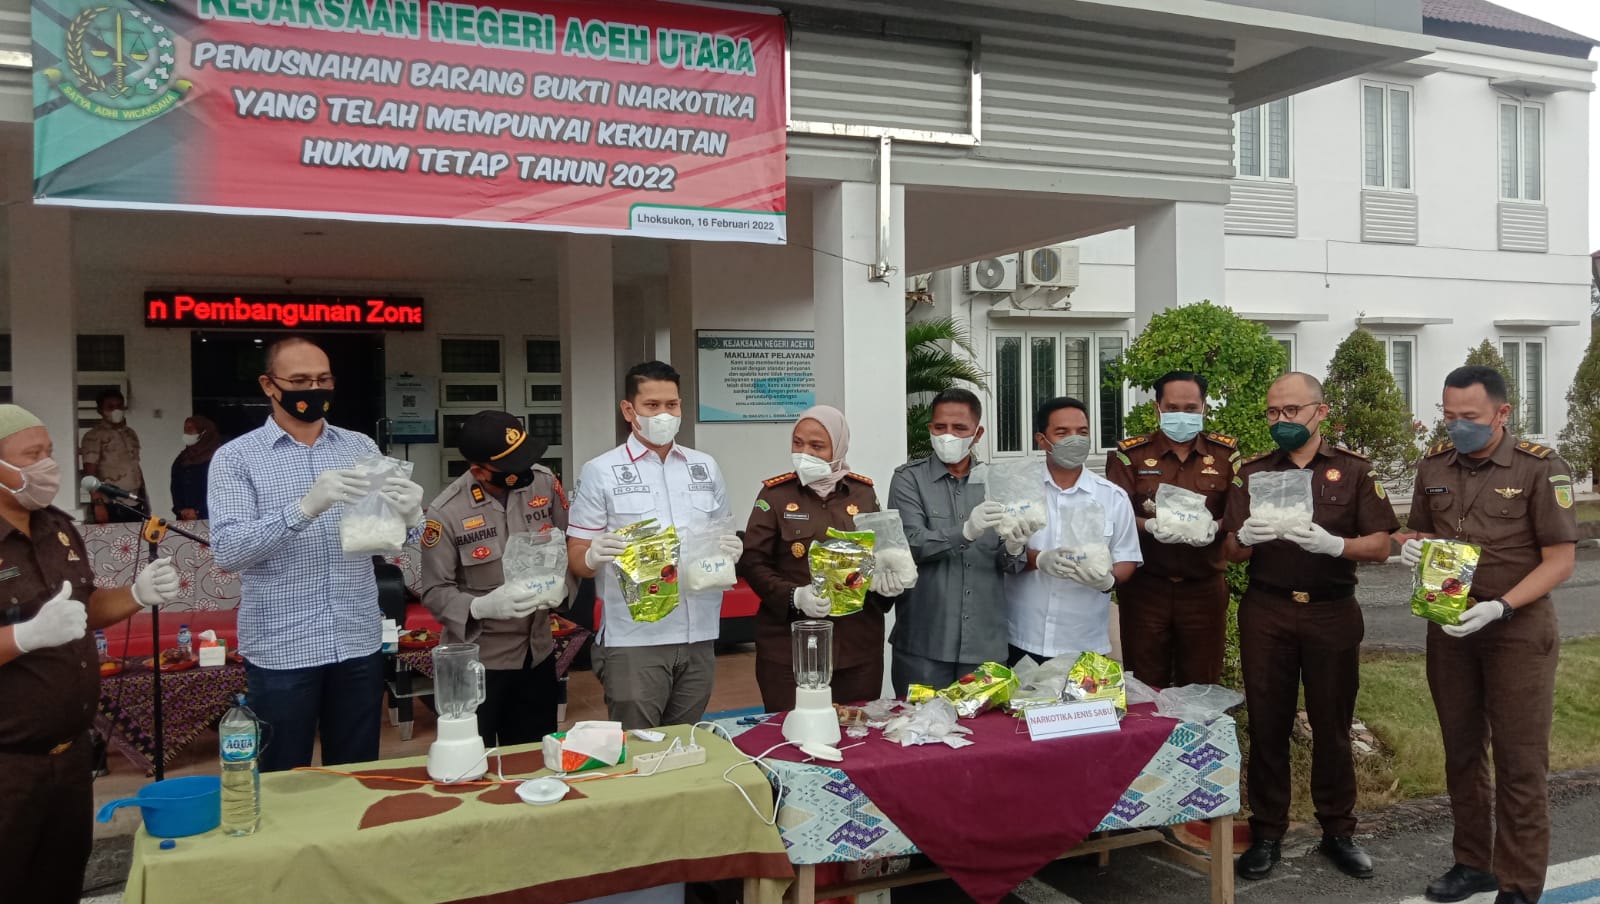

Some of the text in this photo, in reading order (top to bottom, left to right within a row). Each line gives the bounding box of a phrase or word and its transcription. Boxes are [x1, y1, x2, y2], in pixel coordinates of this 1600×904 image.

[429, 2, 555, 54] NEGERI
[563, 17, 650, 64] ACEH
[658, 29, 756, 75] UTARA
[194, 42, 756, 119] PEMUSNAHAN BARANG BUKTI NARKOTIKA
[95, 107, 118, 118] ADHI
[233, 89, 728, 155] YANG TELAH MEMPUNYAI KEKUATAN
[302, 139, 675, 190] HUKUM TETAP TAHUN 2022
[637, 213, 775, 231] Lhoksukon, 16 Februari 2022
[174, 296, 362, 327] Pembangunan
[765, 340, 789, 348] NEGERI
[791, 340, 807, 348] ACEH
[1030, 708, 1113, 725] NARKOTIKA JENIS SABU
[226, 739, 253, 750] AQUA
